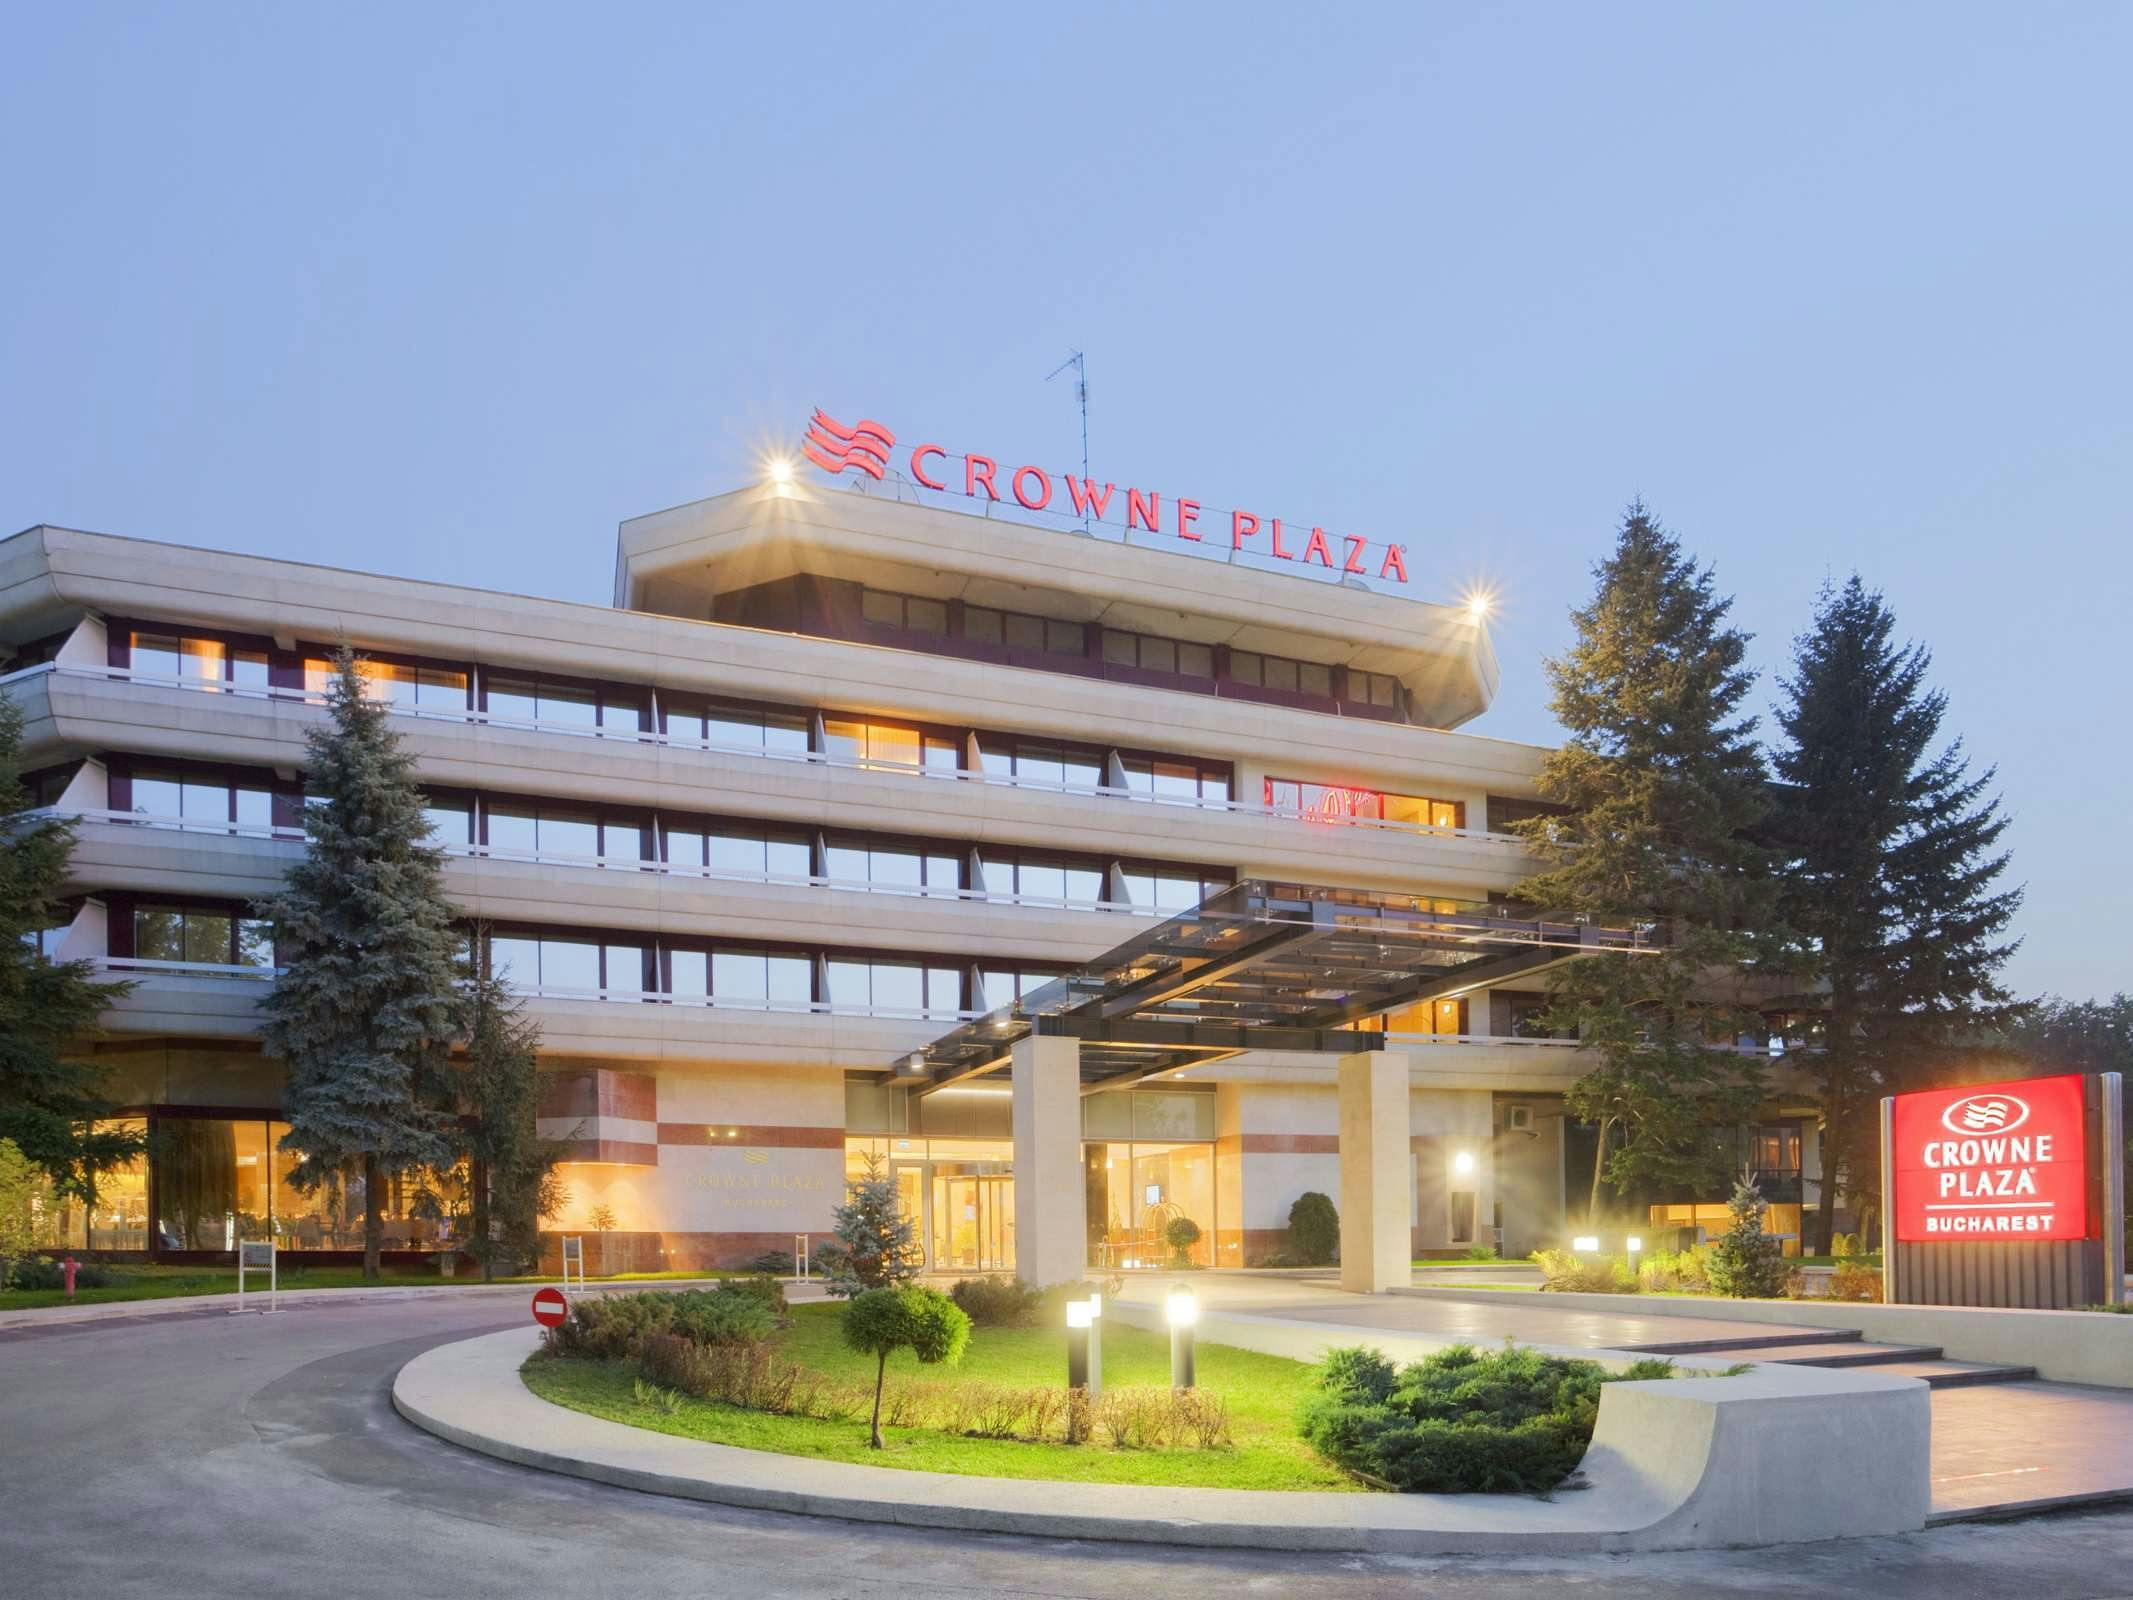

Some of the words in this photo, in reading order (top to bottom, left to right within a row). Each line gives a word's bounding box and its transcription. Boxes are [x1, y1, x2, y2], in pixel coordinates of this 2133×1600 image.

[911, 444, 1202, 541] CROWNE
[1232, 511, 1408, 583] PLAZA
[1923, 1135, 2053, 1168] CROWNE
[1940, 1168, 2036, 1198] PLAZA
[1926, 1215, 2053, 1232] BUCHAREST
